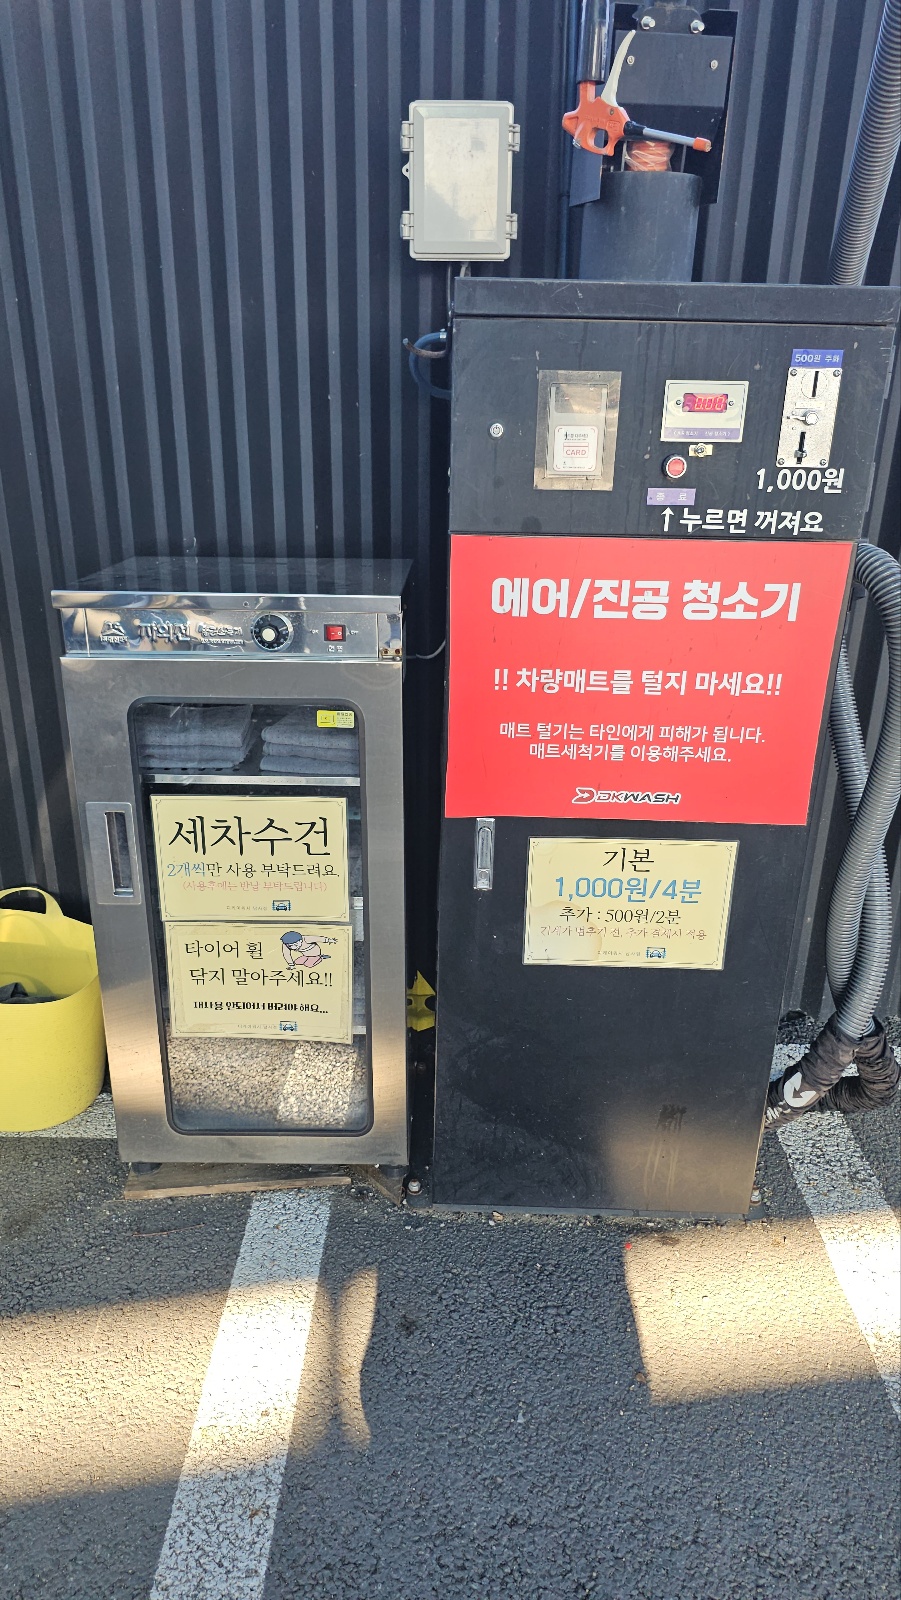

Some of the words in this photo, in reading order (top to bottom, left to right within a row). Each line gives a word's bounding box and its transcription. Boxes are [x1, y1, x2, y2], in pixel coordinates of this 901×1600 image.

[794, 354, 822, 363] 500원
[756, 468, 845, 494] 1,000원
[679, 507, 748, 534] 누르면
[754, 510, 824, 536] 꺼져요
[490, 576, 670, 621] 에어/진공
[681, 579, 802, 622] 청소기
[493, 669, 509, 691] !!
[515, 668, 634, 695] 차량매트를
[640, 671, 687, 696] 털지
[694, 672, 783, 697] 마세요!!
[499, 722, 532, 740] 매트
[536, 723, 585, 741] 털기는
[589, 724, 655, 742] 타인에게
[658, 725, 708, 742] 피해가
[713, 726, 766, 744] 됩니다.
[529, 743, 626, 761] 매트세척기를
[630, 744, 732, 763] 이용해주세요.
[595, 790, 682, 805] DKWASH
[168, 815, 331, 858] 세차수건
[167, 862, 222, 878] 2개씩만
[226, 863, 257, 879] 사용
[260, 863, 340, 879] 부탁드려요.
[602, 847, 655, 873] 기본
[182, 881, 236, 892] (사용후에는
[239, 881, 260, 892] 반납
[263, 881, 327, 893] 부탁드립니다)
[555, 876, 702, 904] 1,000원/4분
[559, 906, 593, 924] 추가
[604, 908, 682, 925] 500원/2분
[184, 939, 240, 960] 타이어
[245, 941, 264, 960] 휠
[189, 967, 226, 987] 닦지
[231, 968, 333, 988] 말아주세요!!
[267, 1001, 298, 1011] 버려야
